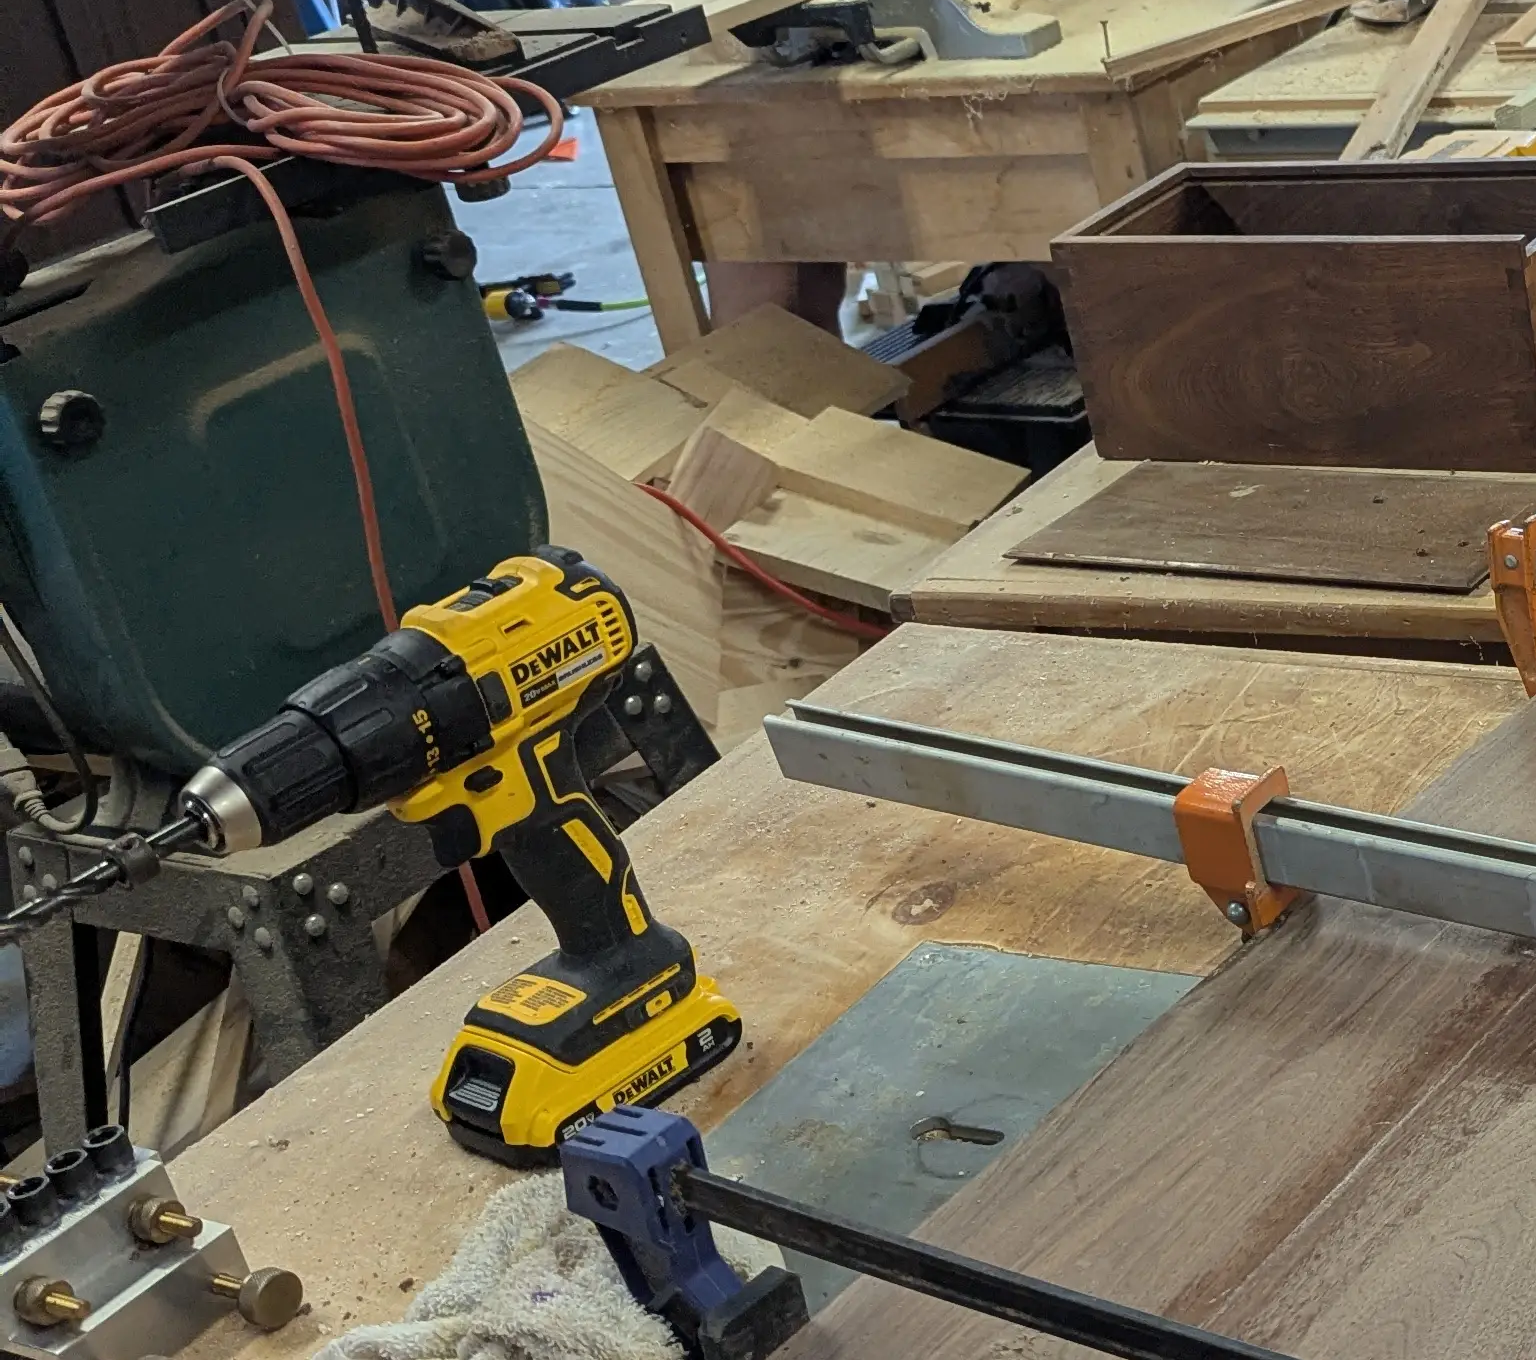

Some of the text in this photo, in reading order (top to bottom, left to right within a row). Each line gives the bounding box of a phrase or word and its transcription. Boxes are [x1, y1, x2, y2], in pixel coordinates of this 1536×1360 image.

[412, 709, 440, 768] 13 15
[697, 1027, 714, 1046] 2
